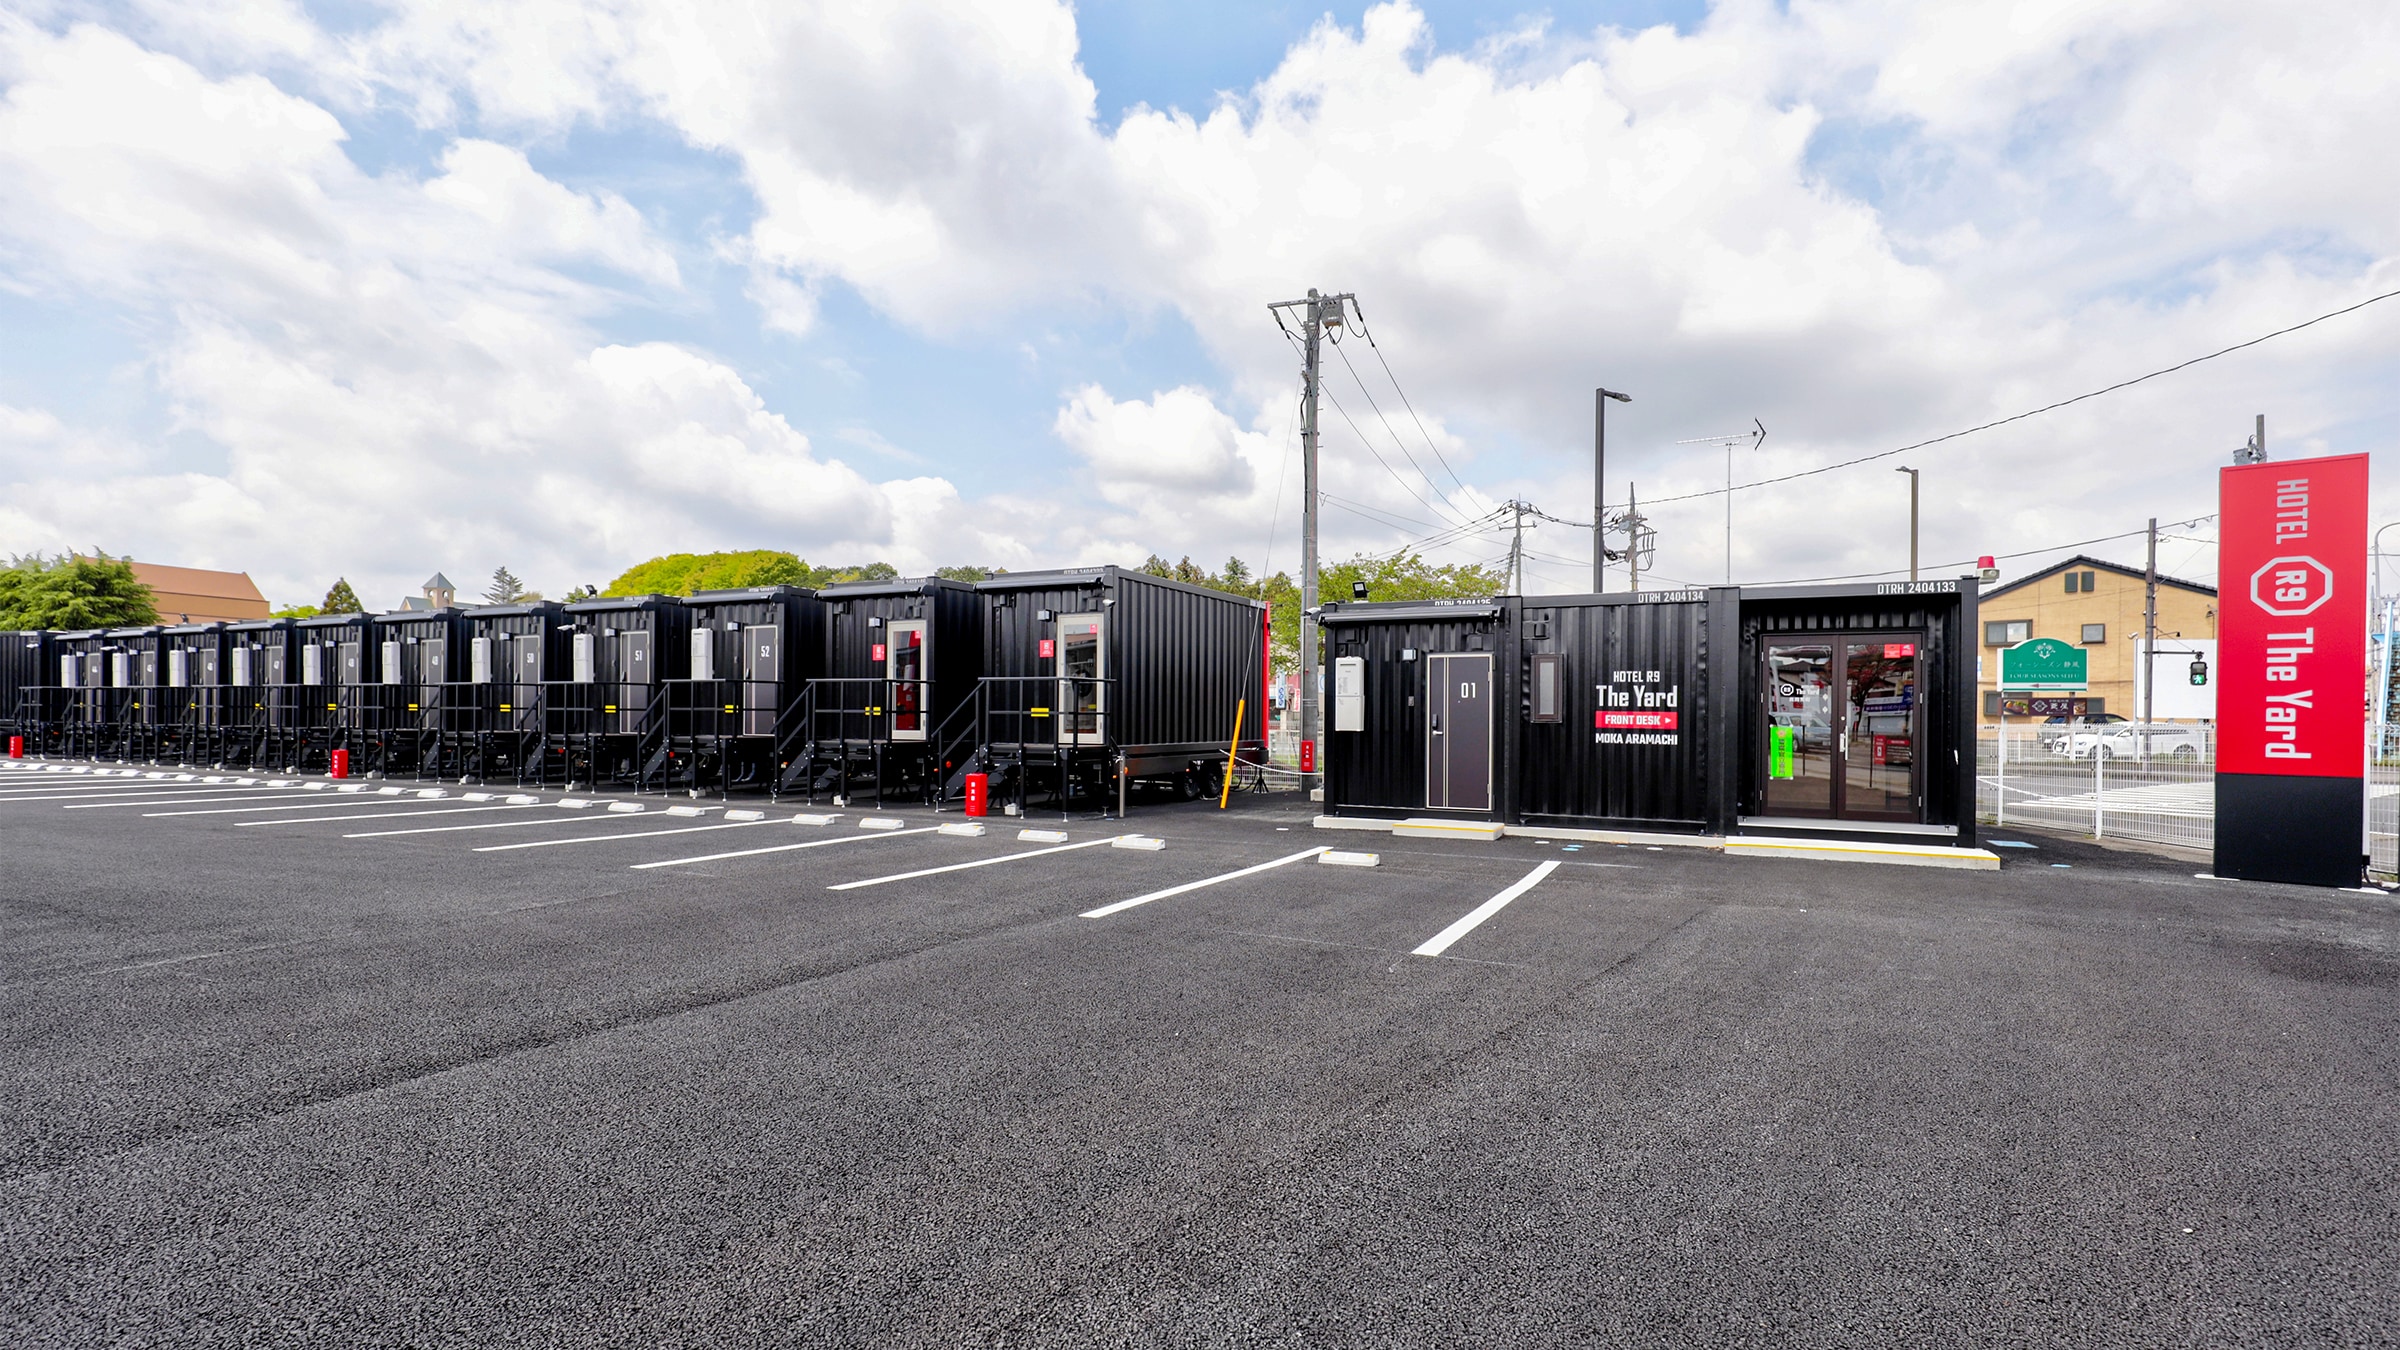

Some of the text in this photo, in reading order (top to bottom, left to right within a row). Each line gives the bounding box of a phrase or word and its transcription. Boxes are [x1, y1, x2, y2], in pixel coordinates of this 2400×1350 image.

[1877, 581, 1956, 595] DTRH 2404133
[1637, 590, 1704, 603] DTRH 2404134
[2265, 478, 2314, 759] HOTEL R9 The Yard
[634, 649, 643, 662] 51
[761, 645, 770, 658] 52
[1613, 671, 1661, 683] HOTEL R9
[1460, 682, 1476, 699] 01
[1596, 685, 1678, 708] The Yard
[1604, 714, 1661, 726] FRONT DESK
[1595, 733, 1678, 746] MOKA ARAMACHI
